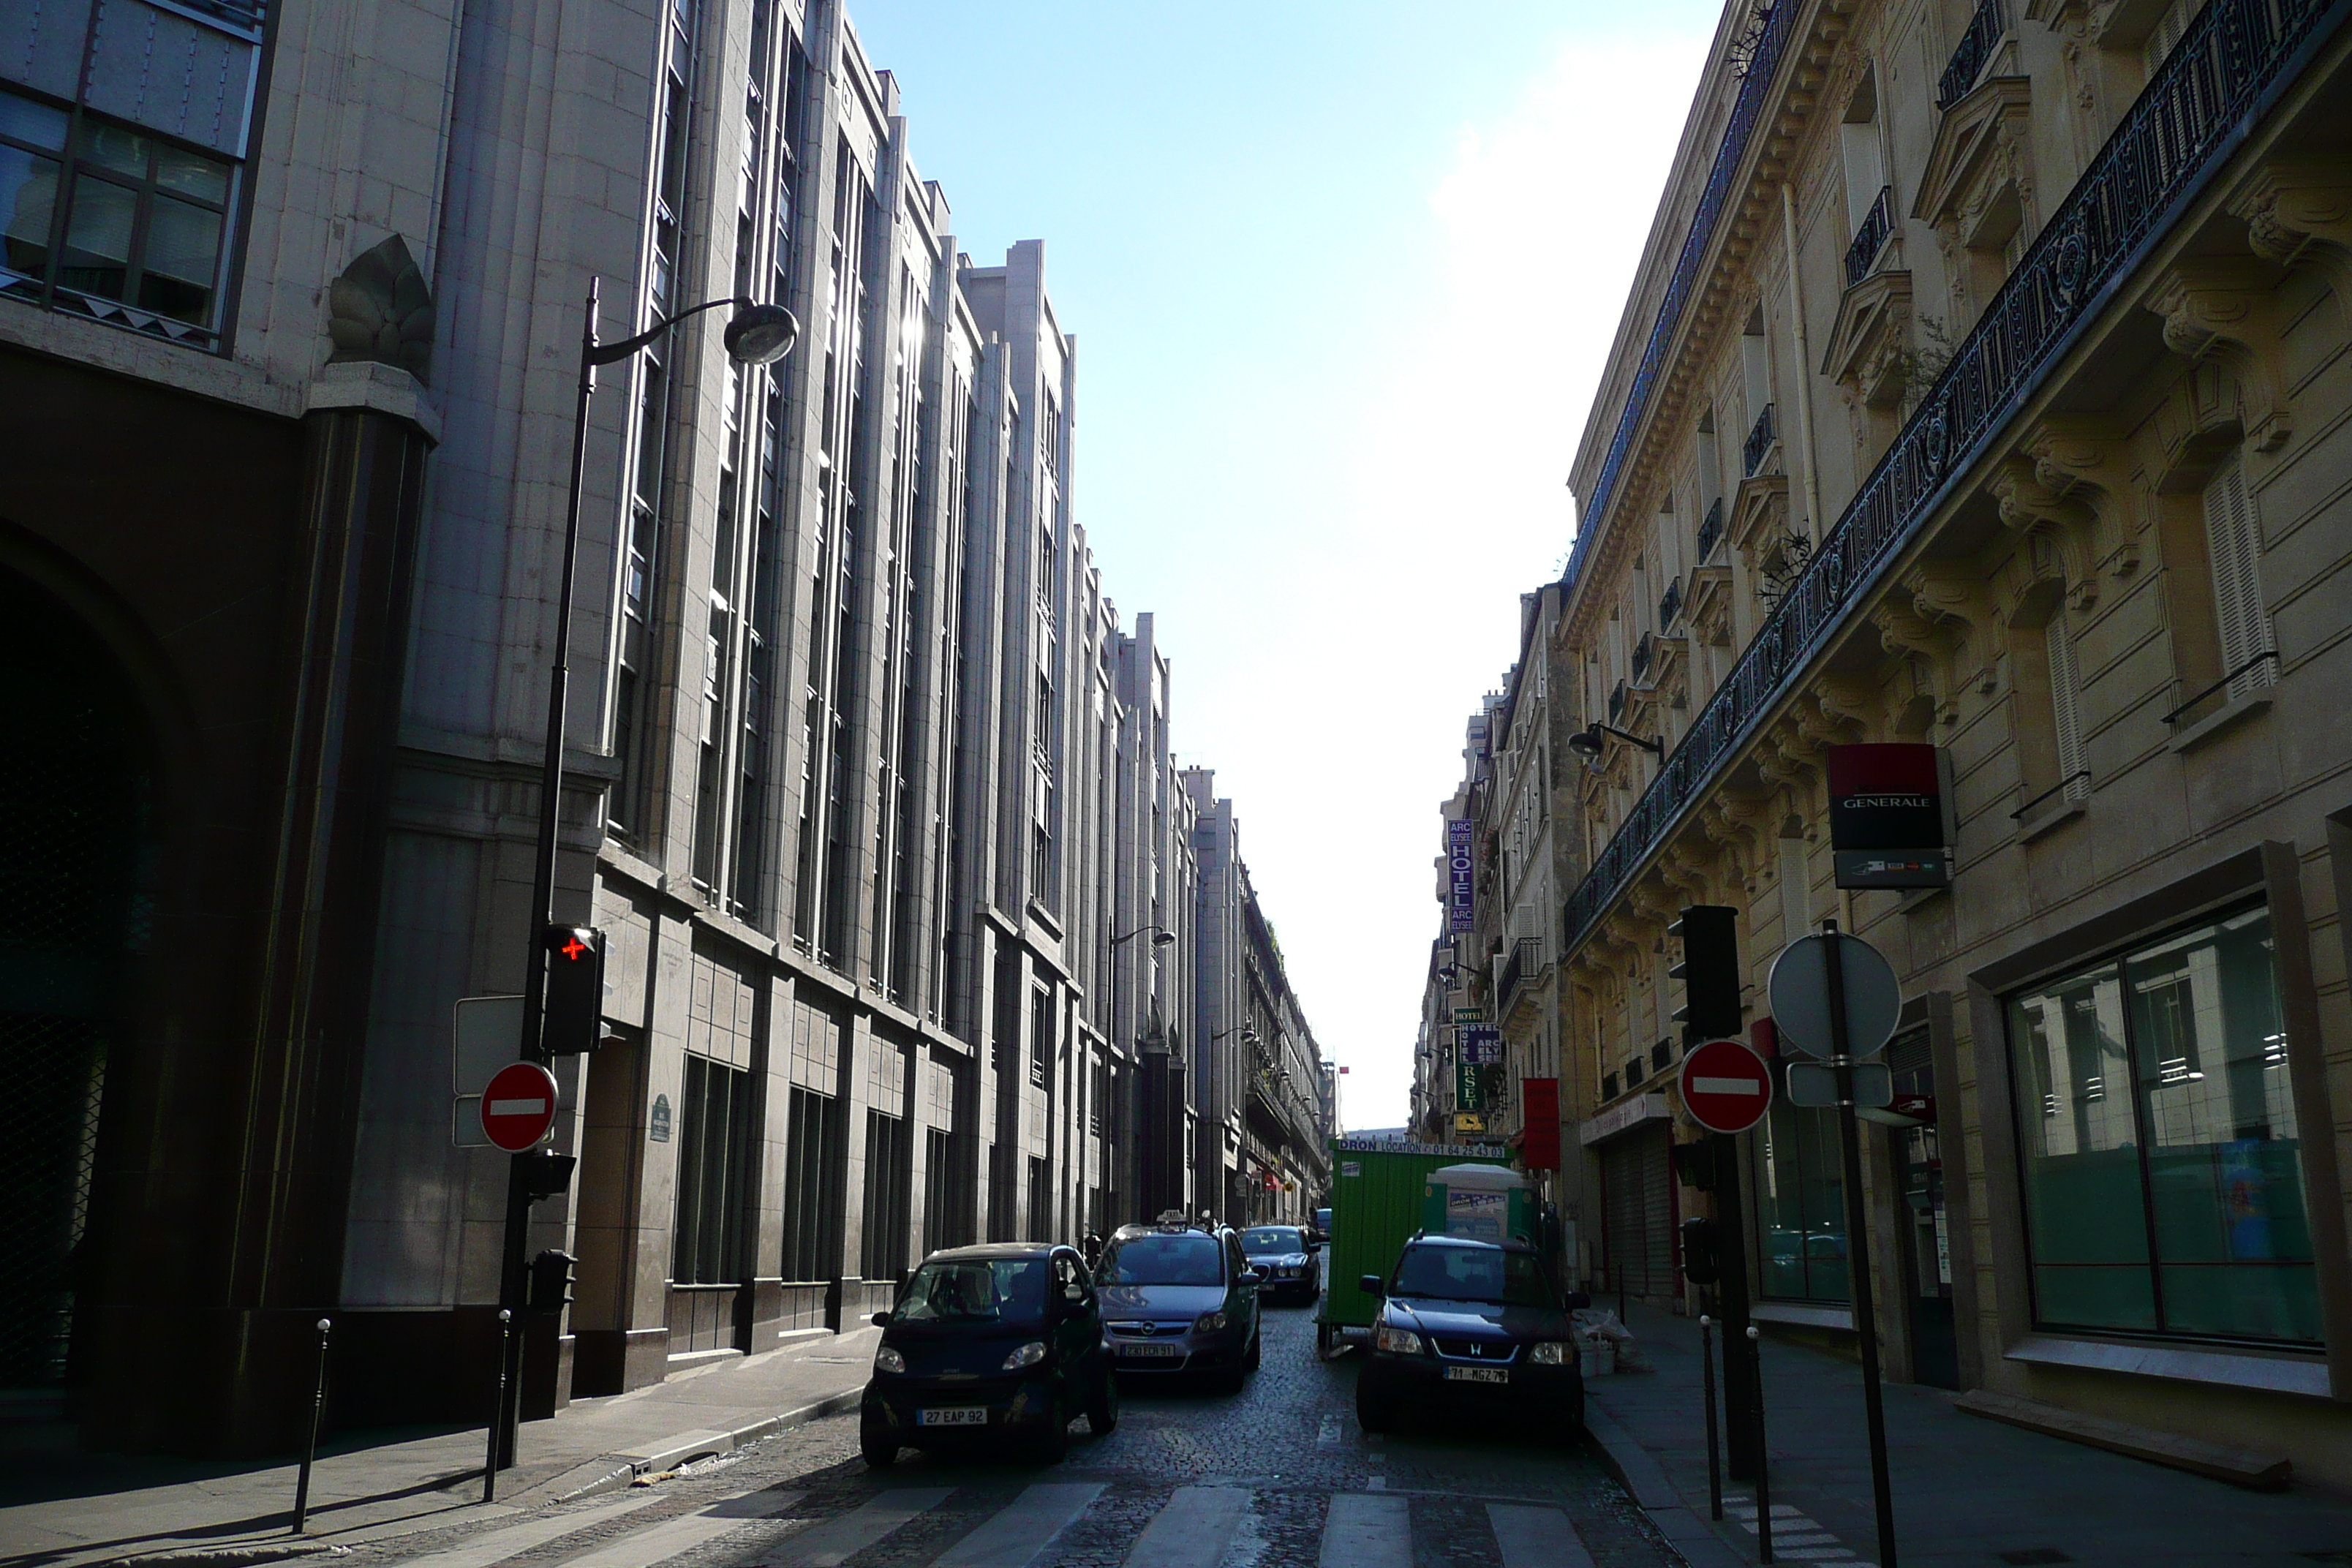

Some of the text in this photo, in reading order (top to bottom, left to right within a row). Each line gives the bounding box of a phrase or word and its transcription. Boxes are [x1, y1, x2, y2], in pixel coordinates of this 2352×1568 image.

[1843, 798, 1930, 808] GENERALE
[1450, 823, 1471, 832] ARC
[1450, 833, 1471, 842] ELYSEE
[1452, 845, 1471, 906] HOTEL
[1452, 911, 1472, 919] ARC
[1452, 921, 1472, 930] ELYSEE
[1463, 1063, 1477, 1109] RSET
[1340, 1140, 1503, 1157] DRON LOCATION 01 64 25 43 03
[1161, 1346, 1170, 1355] 91
[1452, 1368, 1463, 1379] 71
[927, 1411, 983, 1422] 27 EAP 92
